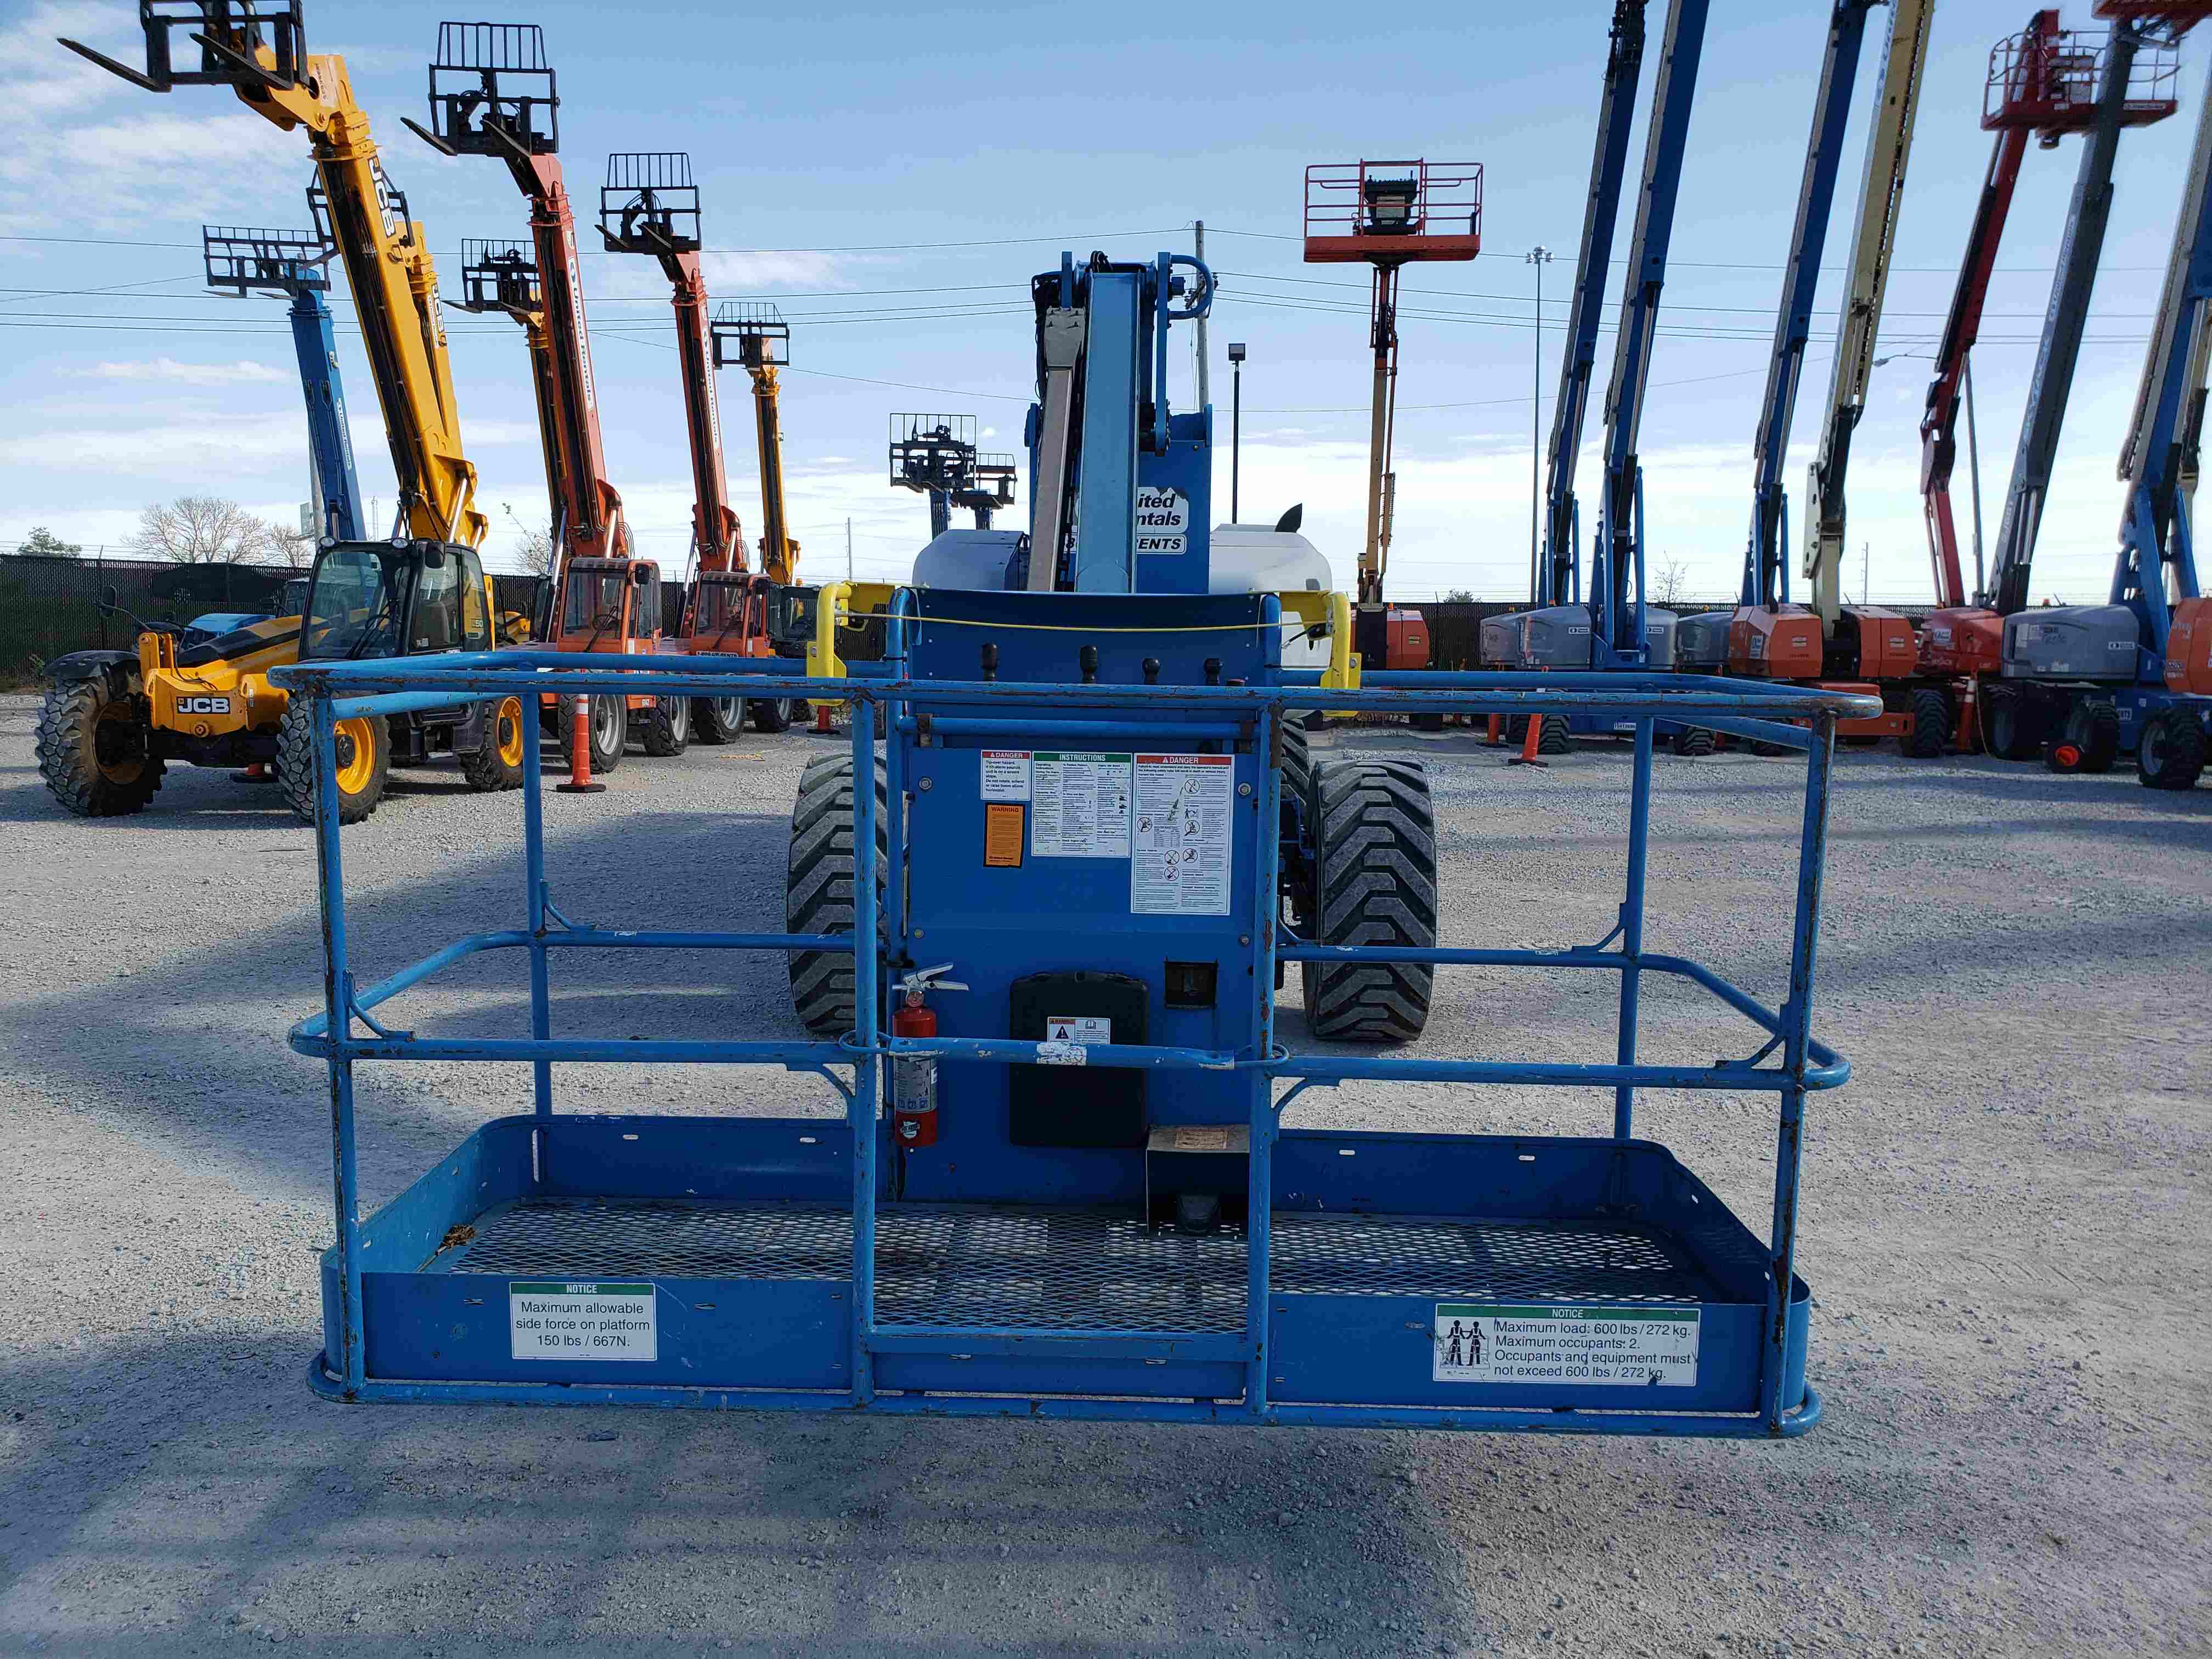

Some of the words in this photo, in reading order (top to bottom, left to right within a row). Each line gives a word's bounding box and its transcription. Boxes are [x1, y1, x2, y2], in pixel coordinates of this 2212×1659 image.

[369, 157, 395, 236] JCB
[432, 285, 444, 332] JCB
[1138, 494, 1176, 508] ited
[1137, 511, 1181, 526] ntals
[1137, 538, 1181, 550] ENTS
[178, 698, 229, 713] JCB
[566, 1284, 597, 1294] NOTICE
[521, 1302, 581, 1313] Maximum
[586, 1302, 644, 1313] allowable
[1552, 1309, 1583, 1318] NOTICE
[516, 1318, 541, 1329] side
[546, 1318, 576, 1329] force
[580, 1321, 595, 1330] on
[600, 1319, 650, 1332] platform
[1496, 1321, 1556, 1333] Maximum
[1560, 1323, 1590, 1334] load:
[1594, 1324, 1617, 1334] 600
[1620, 1324, 1637, 1335] lbs
[1638, 1324, 1645, 1335] /
[1646, 1324, 1669, 1335] 272
[1673, 1325, 1691, 1338] kg.
[538, 1335, 560, 1346] 150
[564, 1335, 582, 1346] lbs
[585, 1335, 589, 1346] /
[593, 1336, 630, 1346] 667N.
[1496, 1335, 1556, 1347] Maximum
[1559, 1338, 1626, 1351] occupants:
[1629, 1338, 1640, 1349] 2.
[1495, 1350, 1561, 1363] Occupants
[1565, 1351, 1588, 1363] and
[1592, 1352, 1658, 1366] equipment
[1661, 1353, 1690, 1364] must
[1494, 1366, 1514, 1376] not
[1517, 1366, 1561, 1377] exceed
[1566, 1367, 1589, 1378] 600
[1592, 1367, 1610, 1378] lbs
[1612, 1367, 1618, 1378] /
[1621, 1367, 1644, 1378] 272
[1648, 1368, 1666, 1380] kg.
